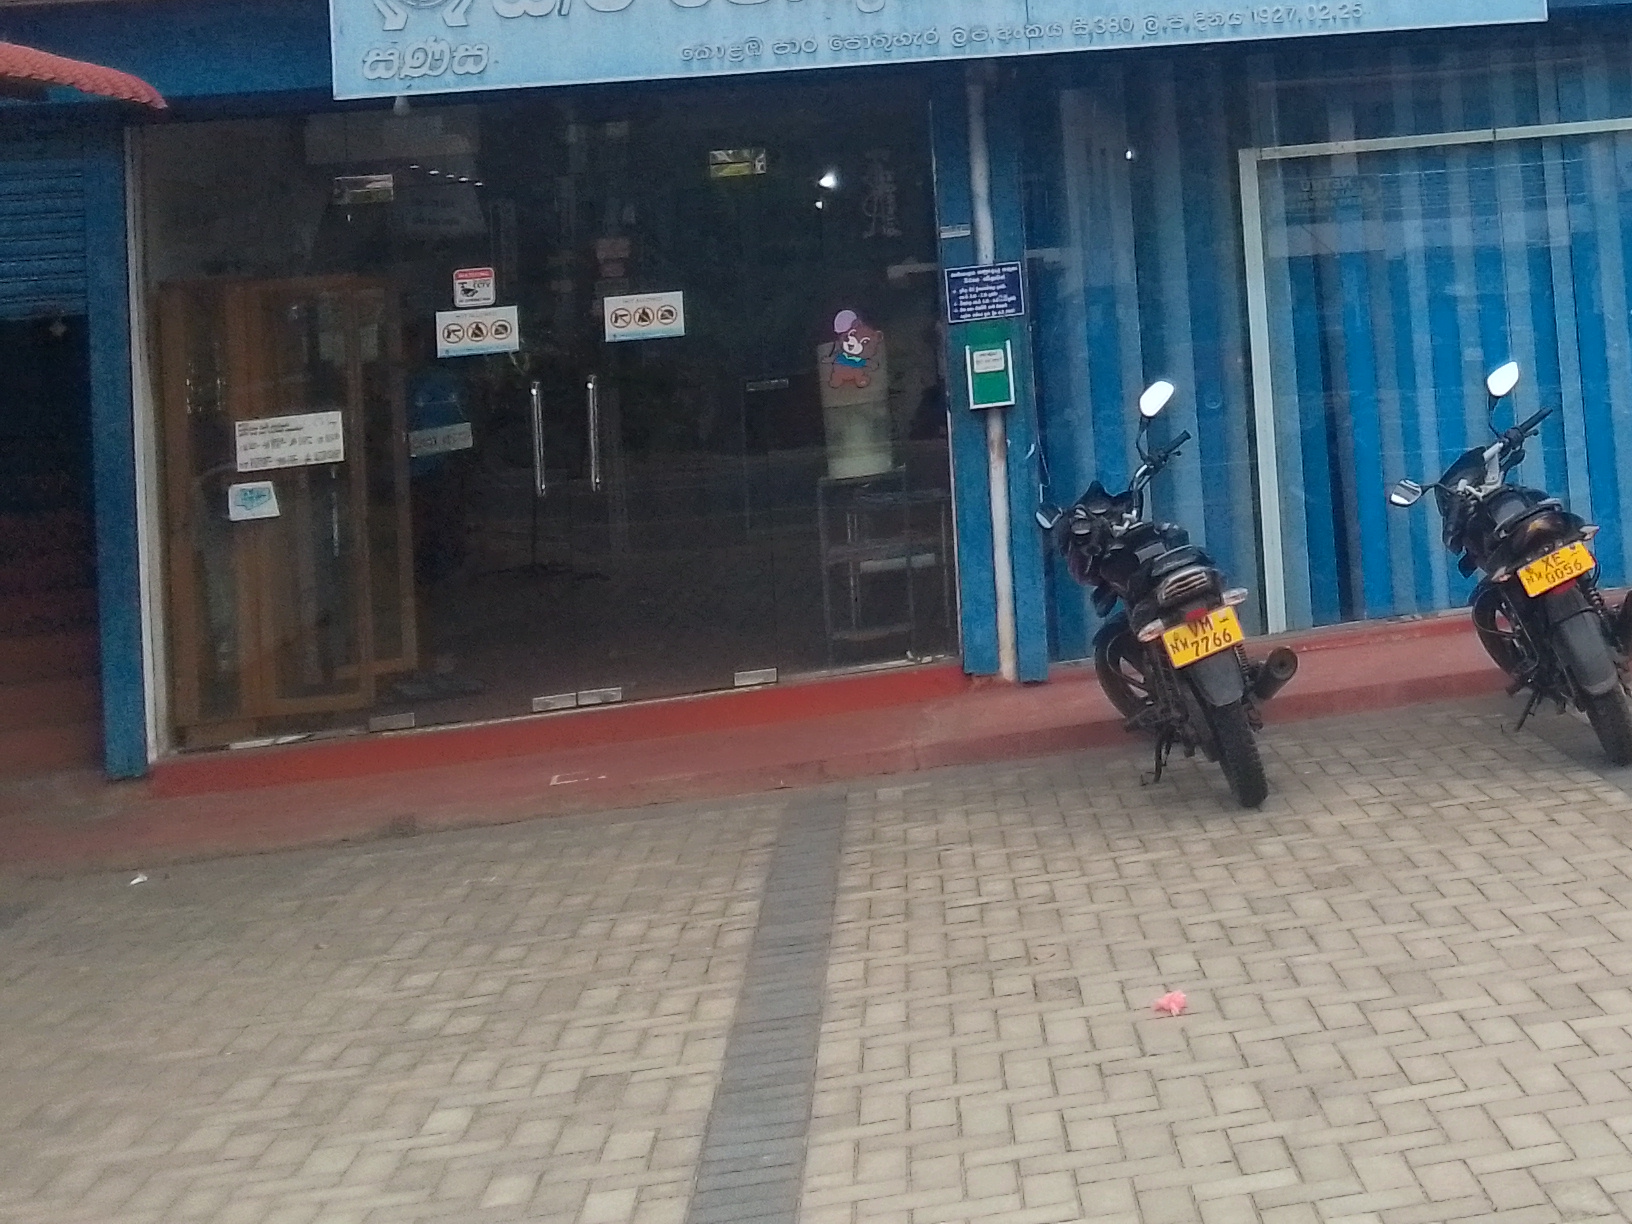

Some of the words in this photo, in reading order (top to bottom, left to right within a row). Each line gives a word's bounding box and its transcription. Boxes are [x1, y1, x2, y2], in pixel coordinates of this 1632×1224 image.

[828, 27, 940, 53] පොතුහැර
[1187, 615, 1213, 637] VM
[1191, 628, 1232, 657] 7766
